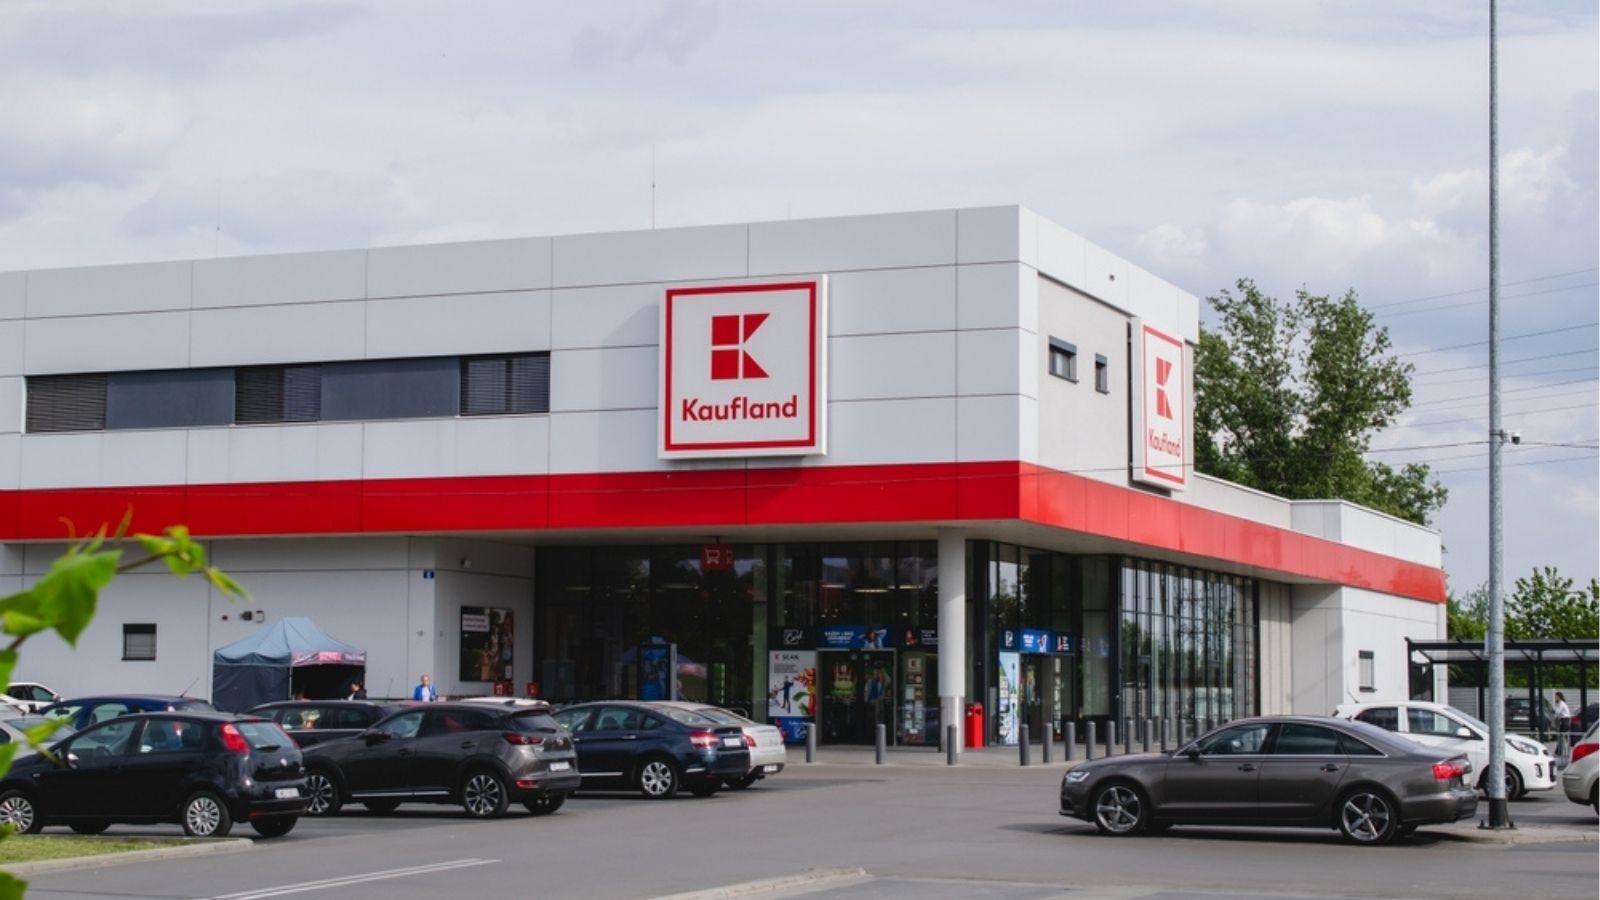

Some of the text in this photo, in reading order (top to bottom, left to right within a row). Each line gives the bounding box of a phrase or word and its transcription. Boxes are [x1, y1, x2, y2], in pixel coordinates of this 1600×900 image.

[711, 313, 771, 380] K
[682, 394, 798, 422] Kaufland
[1148, 427, 1181, 459] Kaufland
